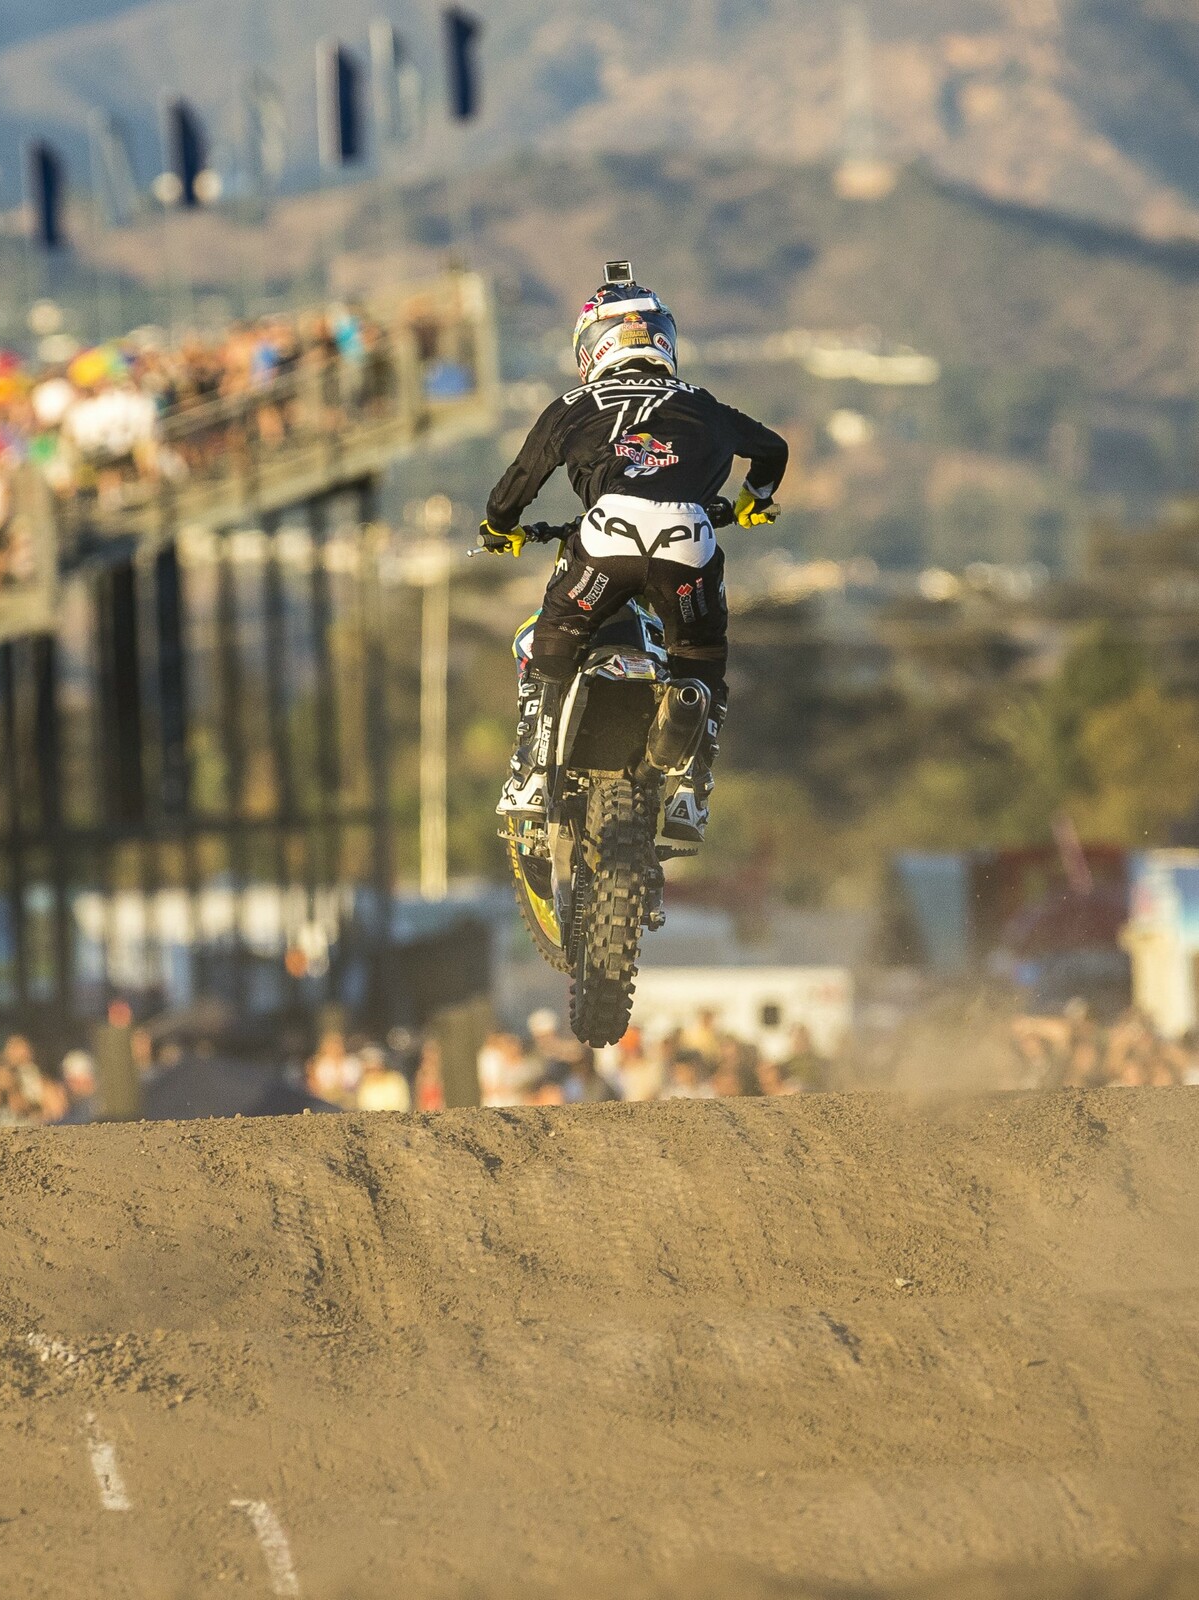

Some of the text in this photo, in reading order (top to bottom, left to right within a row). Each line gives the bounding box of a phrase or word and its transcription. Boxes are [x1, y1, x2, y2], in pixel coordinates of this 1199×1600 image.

[596, 341, 614, 361] BELL
[592, 385, 678, 443] 7
[614, 443, 679, 467] Red Bull
[583, 572, 609, 605] SUZUKI
[538, 714, 553, 767] GAERNE
